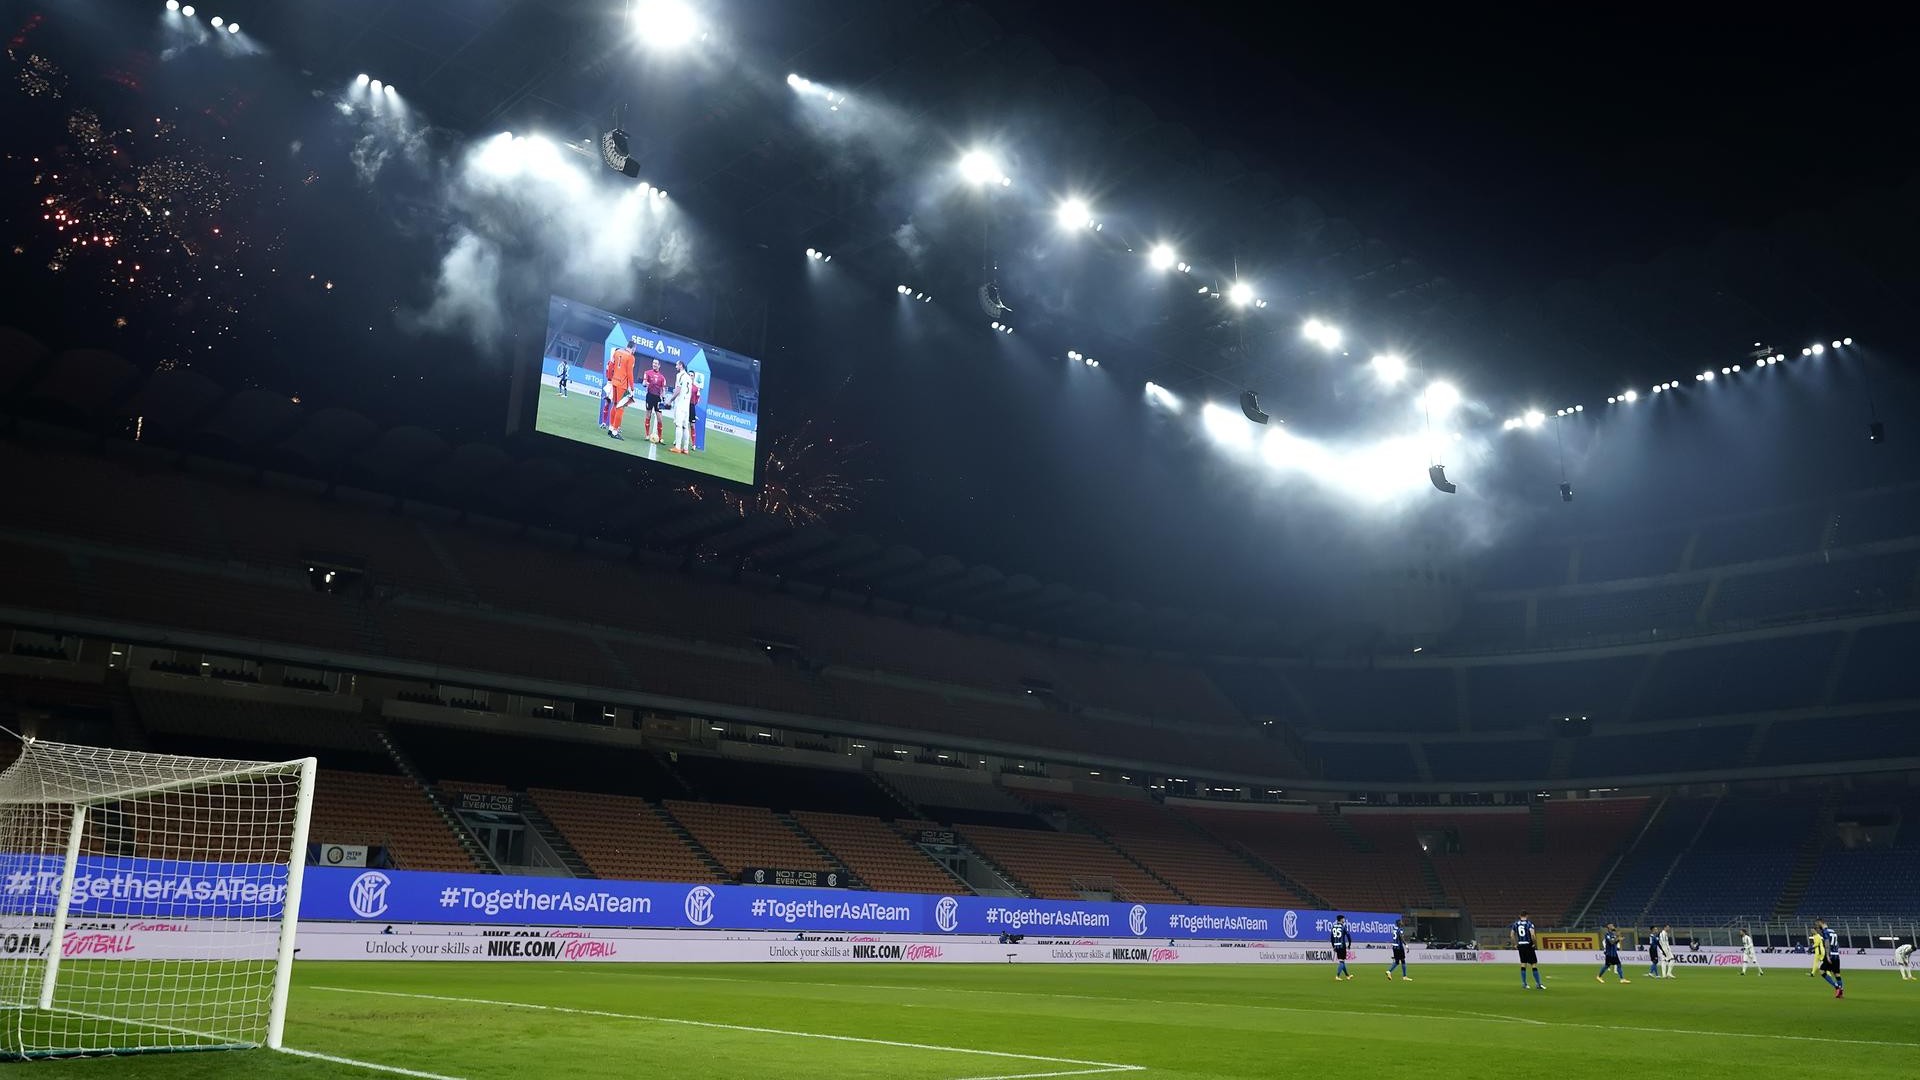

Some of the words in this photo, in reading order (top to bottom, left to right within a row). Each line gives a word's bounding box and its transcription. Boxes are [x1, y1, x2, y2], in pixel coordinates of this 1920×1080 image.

[632, 335, 654, 349] SERIE
[667, 345, 681, 357] TIM
[464, 793, 487, 802] NOT
[491, 795, 514, 804] FOR
[462, 801, 513, 811] EVERYONE
[775, 878, 817, 886] EVERYONE
[440, 887, 651, 915] #TogetherAsATeam
[751, 899, 910, 922] #TogetherAsATeam
[986, 908, 1109, 929] #TogetherAsATeam
[1169, 914, 1268, 931] #TogetherAsATeam
[1332, 927, 1342, 938] 95
[1517, 925, 1526, 937] 6
[366, 941, 408, 954] Unlock
[410, 945, 439, 957] your
[441, 942, 470, 954] skills
[472, 945, 483, 954] at
[1543, 937, 1593, 950] PIRELLI
[769, 946, 798, 957] Unlock
[799, 949, 820, 959] your
[820, 946, 841, 957] skills
[842, 949, 850, 957] at
[1051, 949, 1073, 959] Unlock
[1074, 951, 1089, 961] your
[1089, 949, 1103, 959] skills
[1637, 954, 1651, 962] skill
